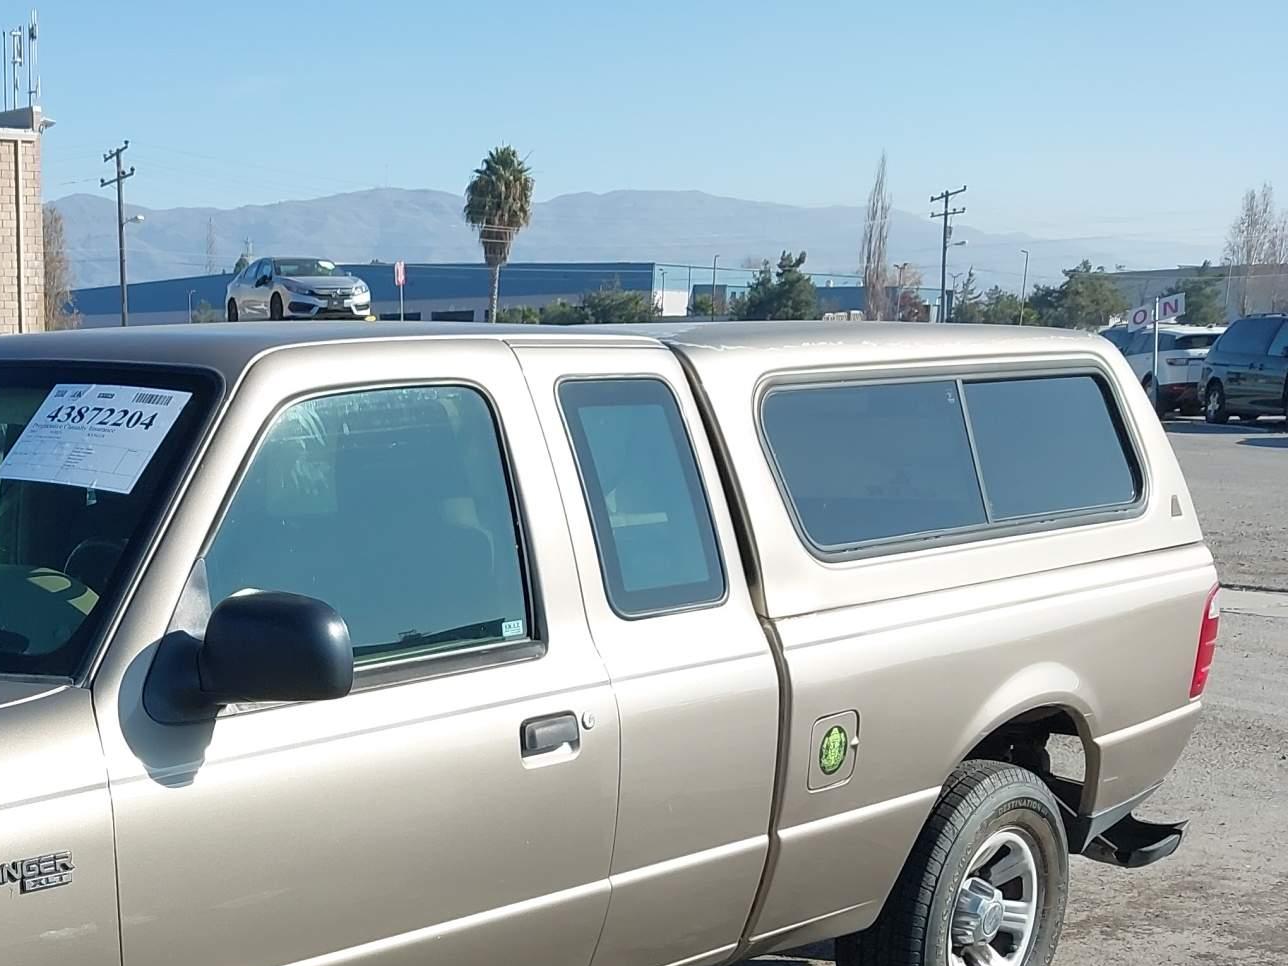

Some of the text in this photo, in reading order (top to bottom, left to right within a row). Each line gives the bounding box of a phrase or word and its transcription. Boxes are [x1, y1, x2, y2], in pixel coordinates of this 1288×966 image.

[1132, 308, 1148, 326] O
[1162, 298, 1179, 317] N
[46, 404, 159, 431] 43872204
